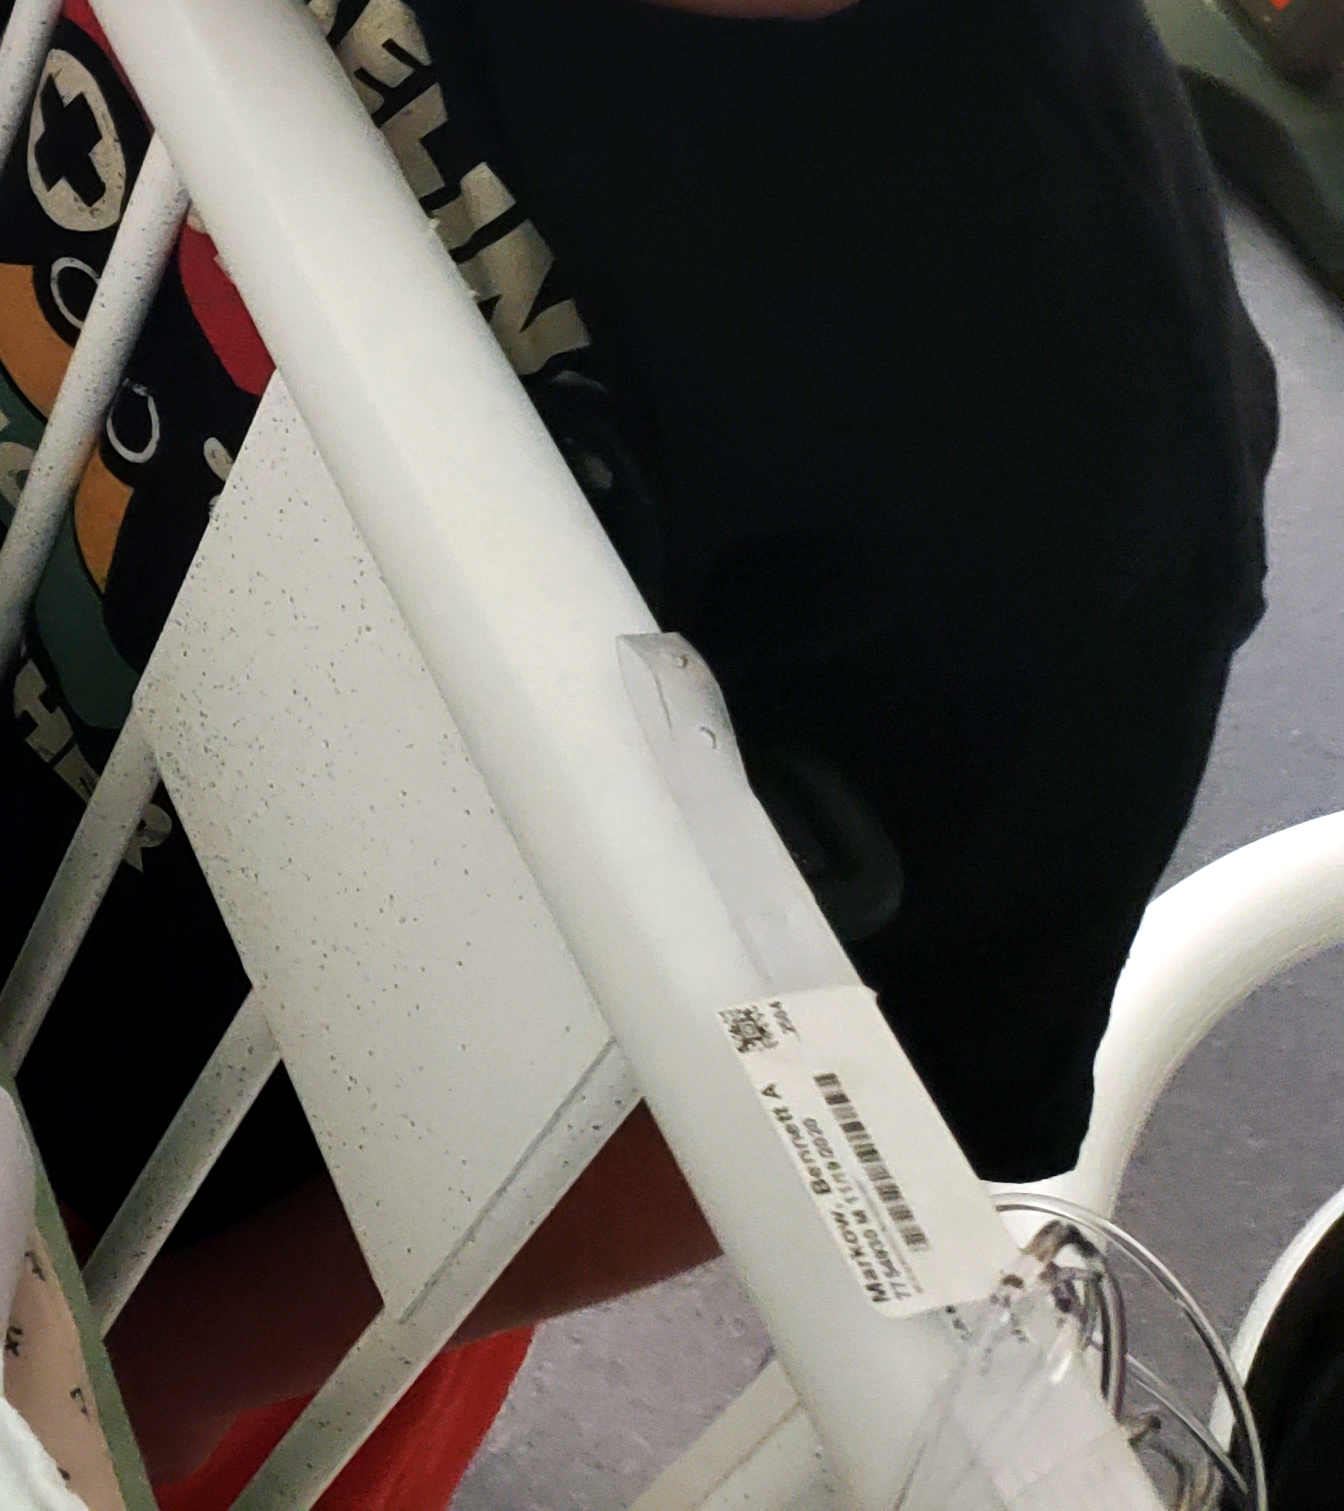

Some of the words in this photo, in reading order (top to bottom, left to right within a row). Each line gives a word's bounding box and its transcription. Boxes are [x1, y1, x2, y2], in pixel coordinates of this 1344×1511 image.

[761, 1083, 783, 1100] A
[773, 1105, 832, 1195] Bennett
[830, 1202, 892, 1304] Markow,
